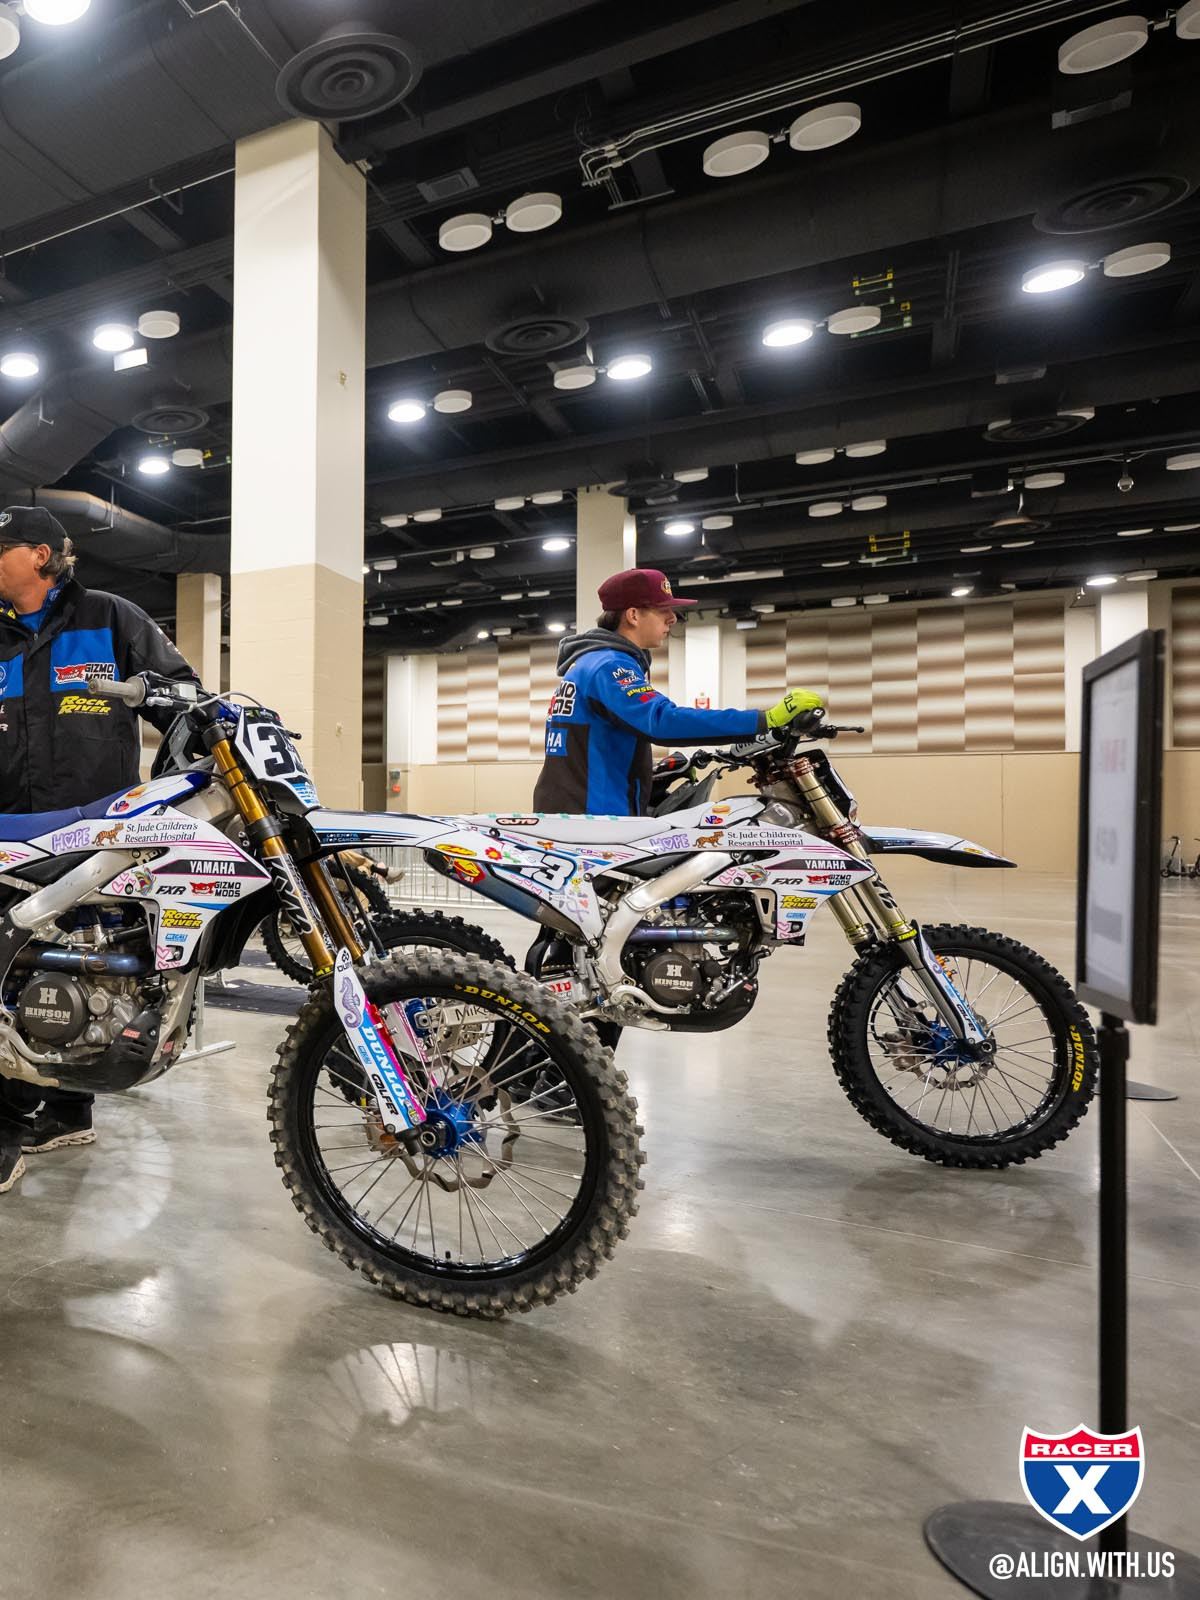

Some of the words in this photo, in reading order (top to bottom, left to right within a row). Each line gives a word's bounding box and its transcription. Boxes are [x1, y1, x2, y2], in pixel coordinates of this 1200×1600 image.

[85, 663, 115, 673] GIZMO
[60, 696, 109, 706] ROCK
[58, 705, 112, 715] RIVER
[125, 823, 136, 832] St.
[137, 823, 155, 833] Jude
[155, 822, 199, 832] Children's
[125, 833, 159, 844] Research
[159, 831, 196, 842] Hospital
[727, 831, 738, 839] St.
[739, 831, 758, 839] Jude
[759, 831, 803, 839] Children's
[727, 839, 761, 847] Research
[761, 839, 804, 847] Hospital
[190, 861, 236, 875] YAMAHA
[805, 860, 847, 870] YAMAHA
[215, 881, 242, 889] GIZMO
[771, 877, 804, 885] FXR
[155, 885, 187, 895] FXR
[215, 889, 241, 898] MODS
[164, 909, 202, 919] ROCK
[161, 918, 203, 929] RIVER
[666, 964, 683, 977] H
[654, 978, 694, 987] HINSON
[38, 987, 58, 1005] H
[24, 1006, 71, 1020] HINSON
[463, 985, 552, 1034] DUNLOP
[1071, 1031, 1085, 1092] DUNLOP
[371, 1074, 399, 1116] GALFER
